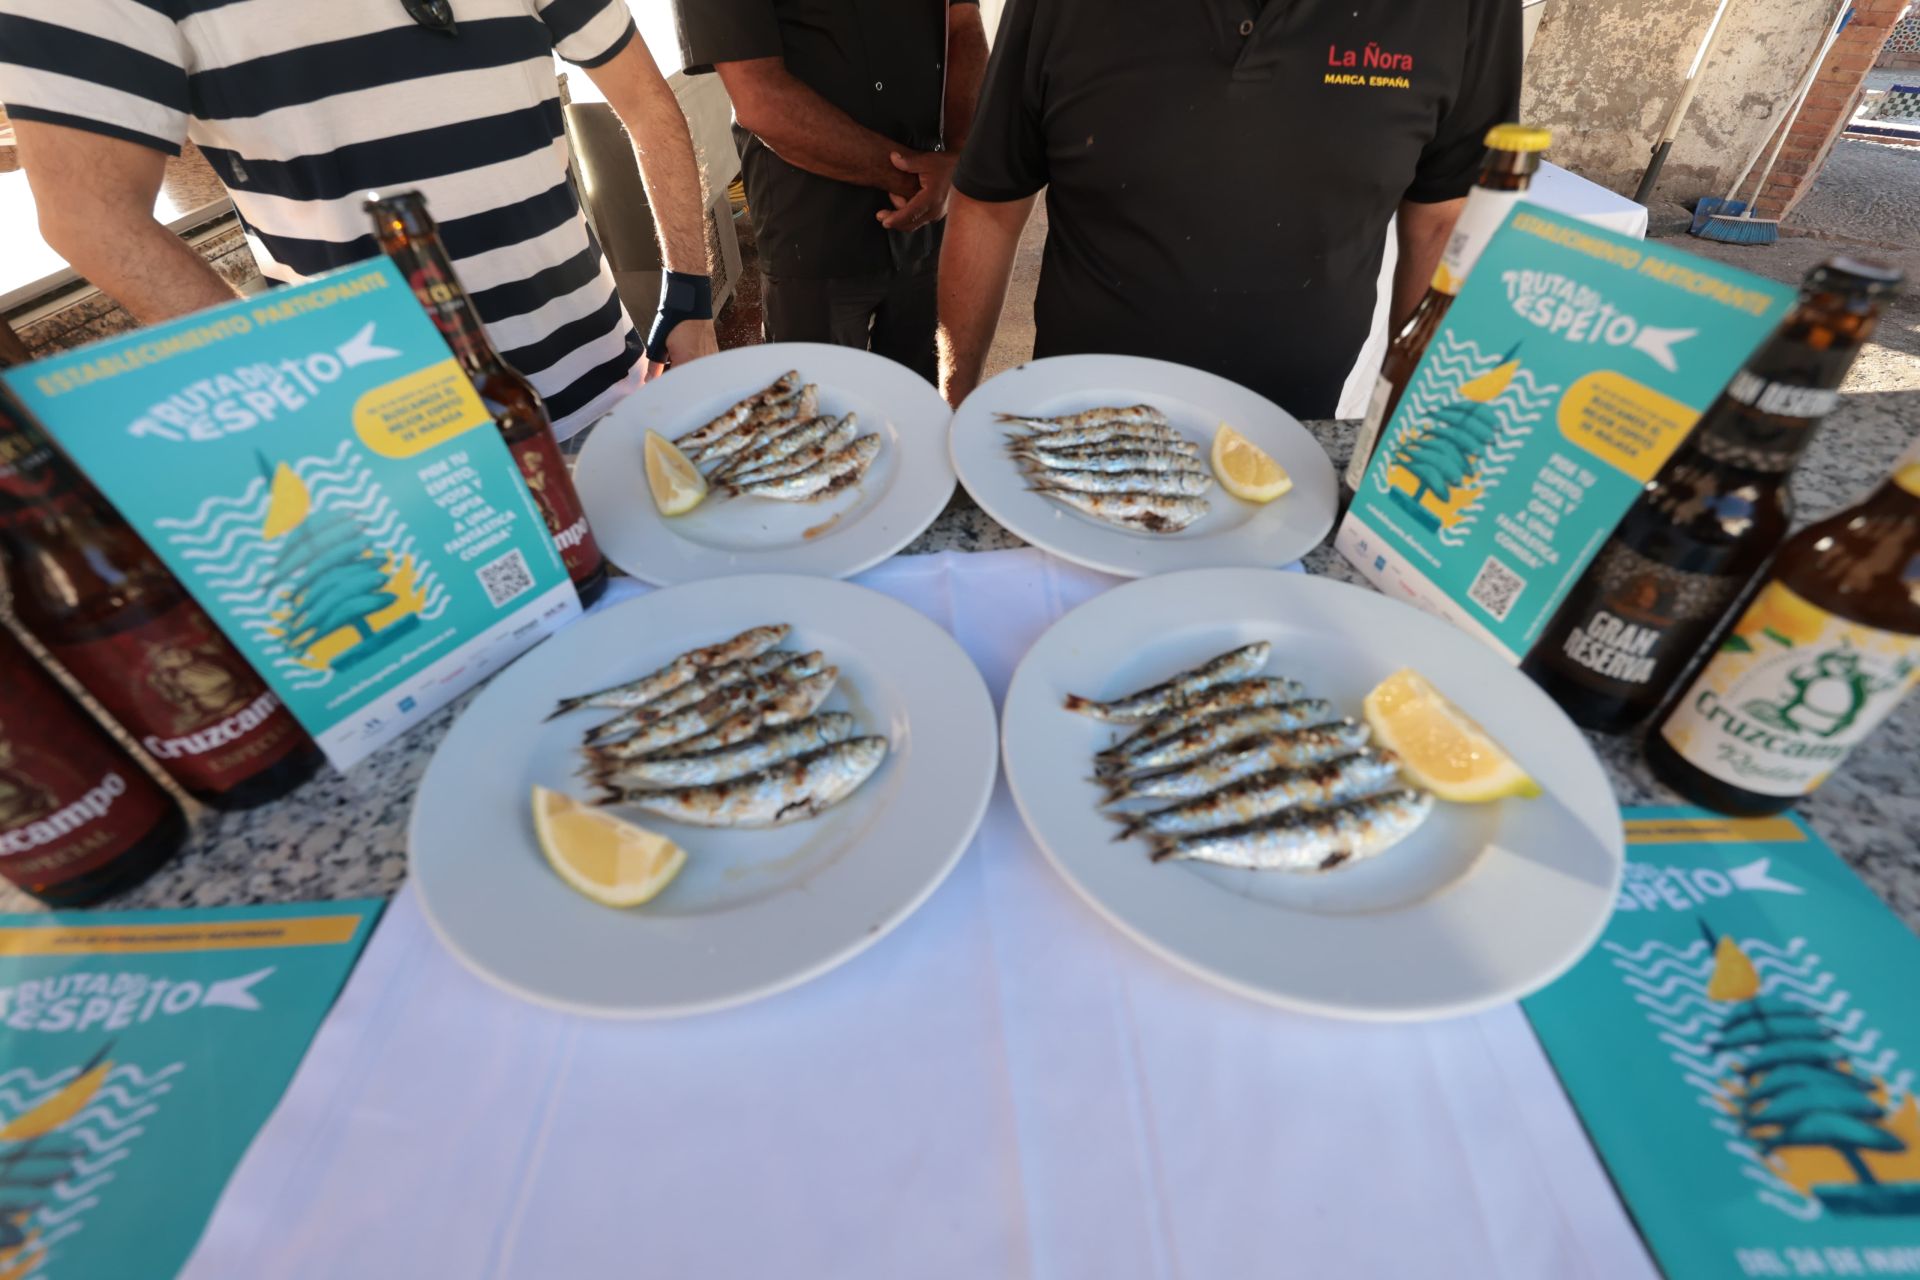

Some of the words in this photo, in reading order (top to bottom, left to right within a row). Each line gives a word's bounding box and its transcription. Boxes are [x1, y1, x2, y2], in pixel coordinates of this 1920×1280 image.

[1324, 74, 1365, 86] MARCA
[1369, 76, 1410, 89] ESPAÑA
[1328, 44, 1356, 67] La
[1363, 42, 1413, 71] Ñora
[35, 312, 253, 397] ESTABLECIMIENTO
[251, 270, 390, 328] PARTICIPANTE
[1512, 295, 1638, 346] ESPETO
[187, 352, 343, 442] ESPETO
[1563, 627, 1656, 684] RESERVA
[1587, 610, 1660, 656] GRAN
[143, 691, 281, 758] Cruzcam
[6, 980, 199, 1032] ESPETO
